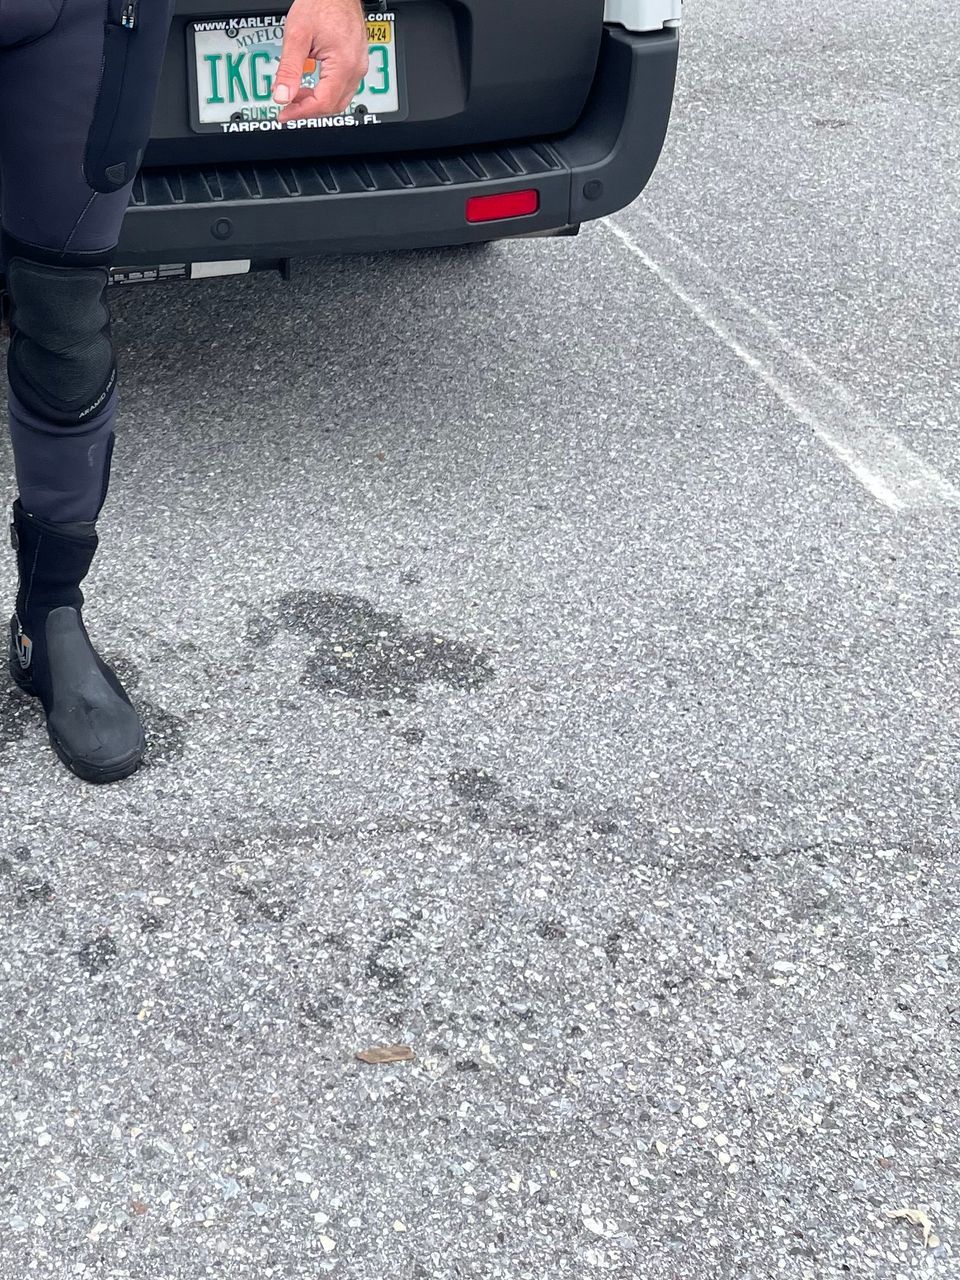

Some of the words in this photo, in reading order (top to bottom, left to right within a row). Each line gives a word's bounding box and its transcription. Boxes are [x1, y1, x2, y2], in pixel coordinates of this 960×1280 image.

[235, 25, 284, 49] MYFLO
[221, 120, 283, 133] TARPON
[286, 115, 359, 131] SPRINGS,
[364, 114, 381, 125] FL
